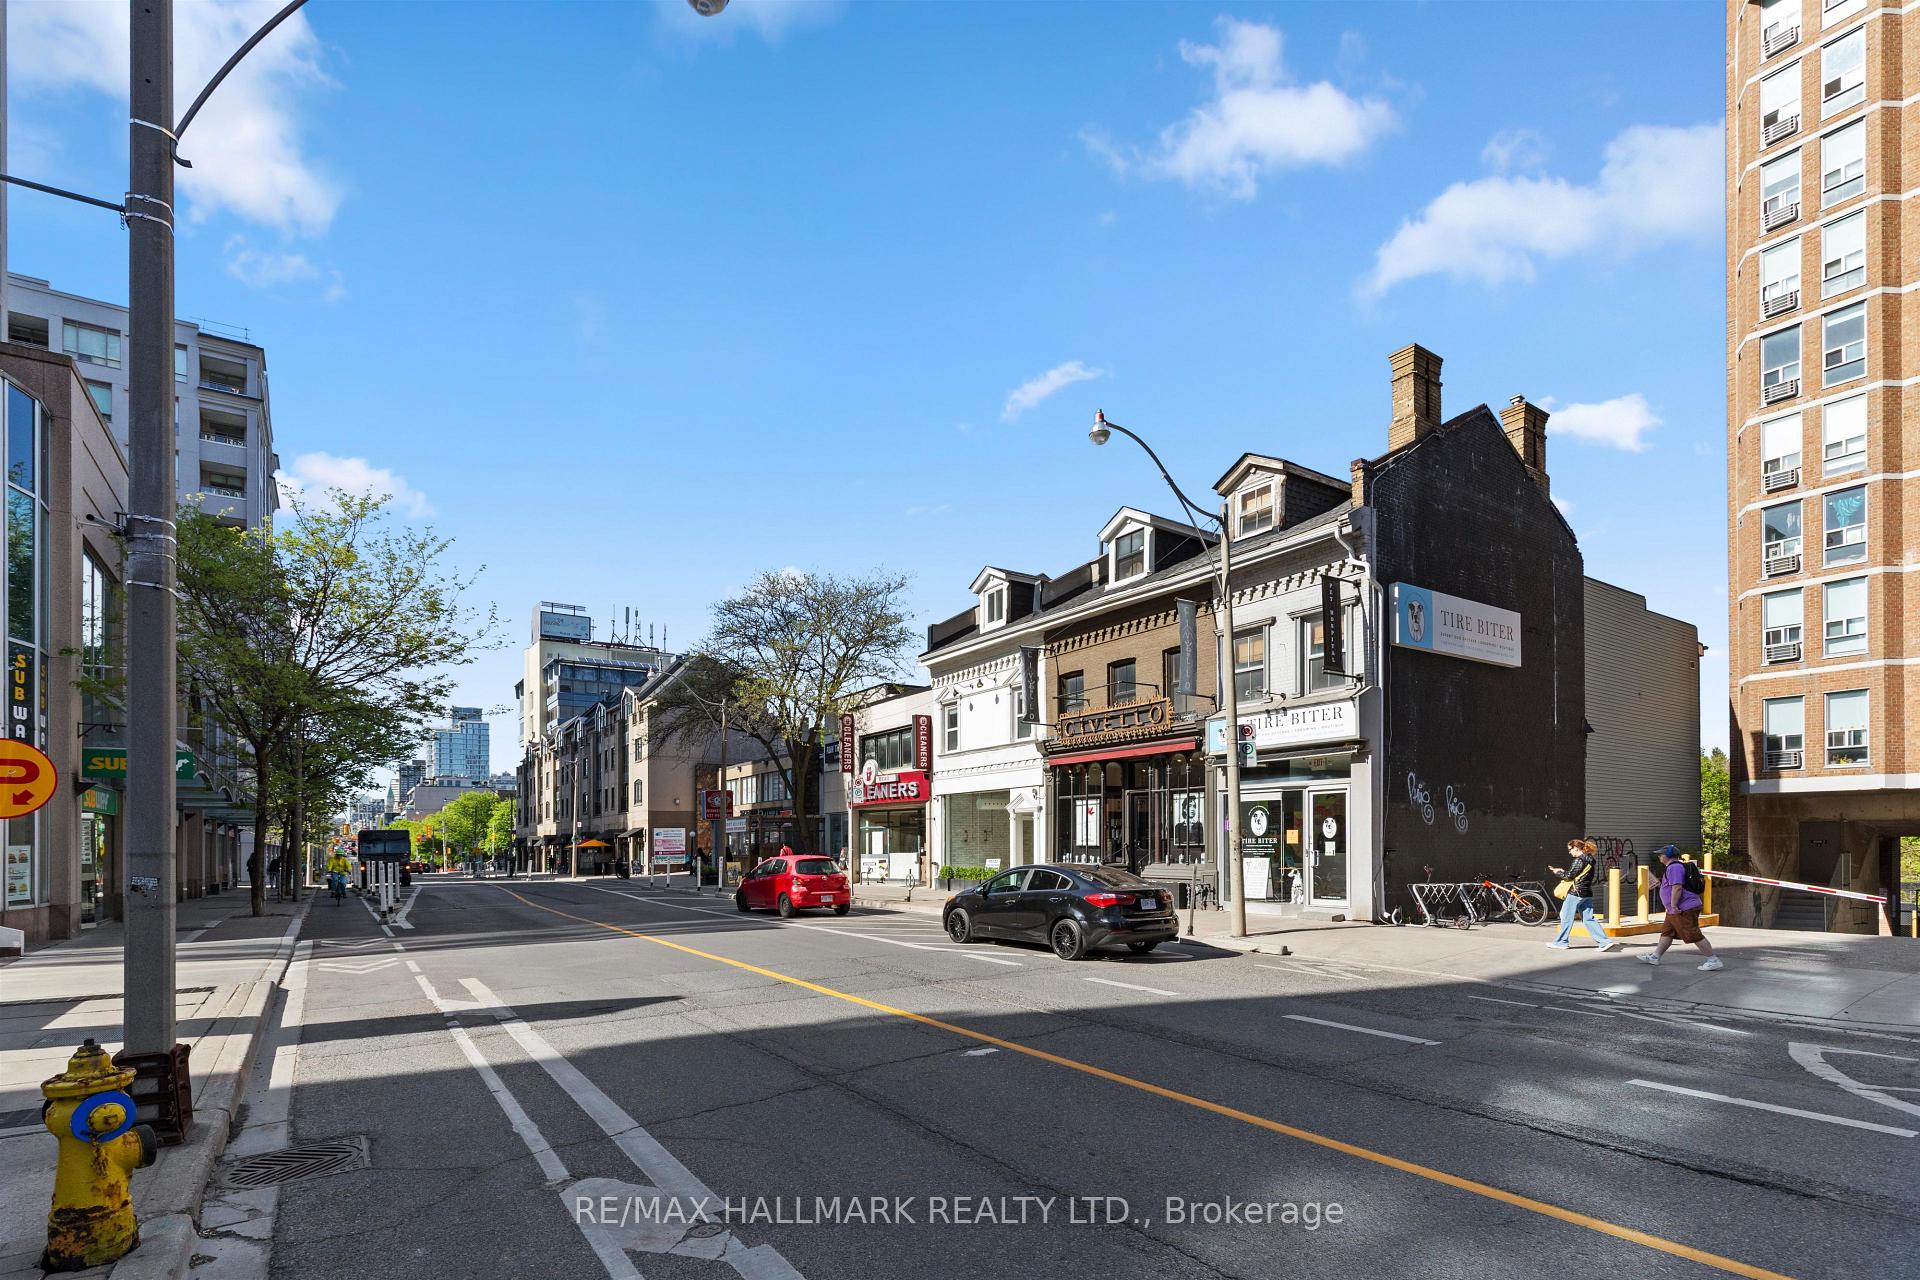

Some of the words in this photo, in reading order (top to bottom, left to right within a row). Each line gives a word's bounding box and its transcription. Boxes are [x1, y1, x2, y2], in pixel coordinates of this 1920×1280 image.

[1440, 609, 1473, 632] TIRE
[1477, 618, 1514, 641] BITER
[13, 654, 28, 738] SUBWA
[1064, 705, 1163, 738] CIVELLO
[1291, 706, 1343, 726] BITER
[843, 726, 852, 770] CLEANERS
[920, 726, 928, 767] CLEANERS
